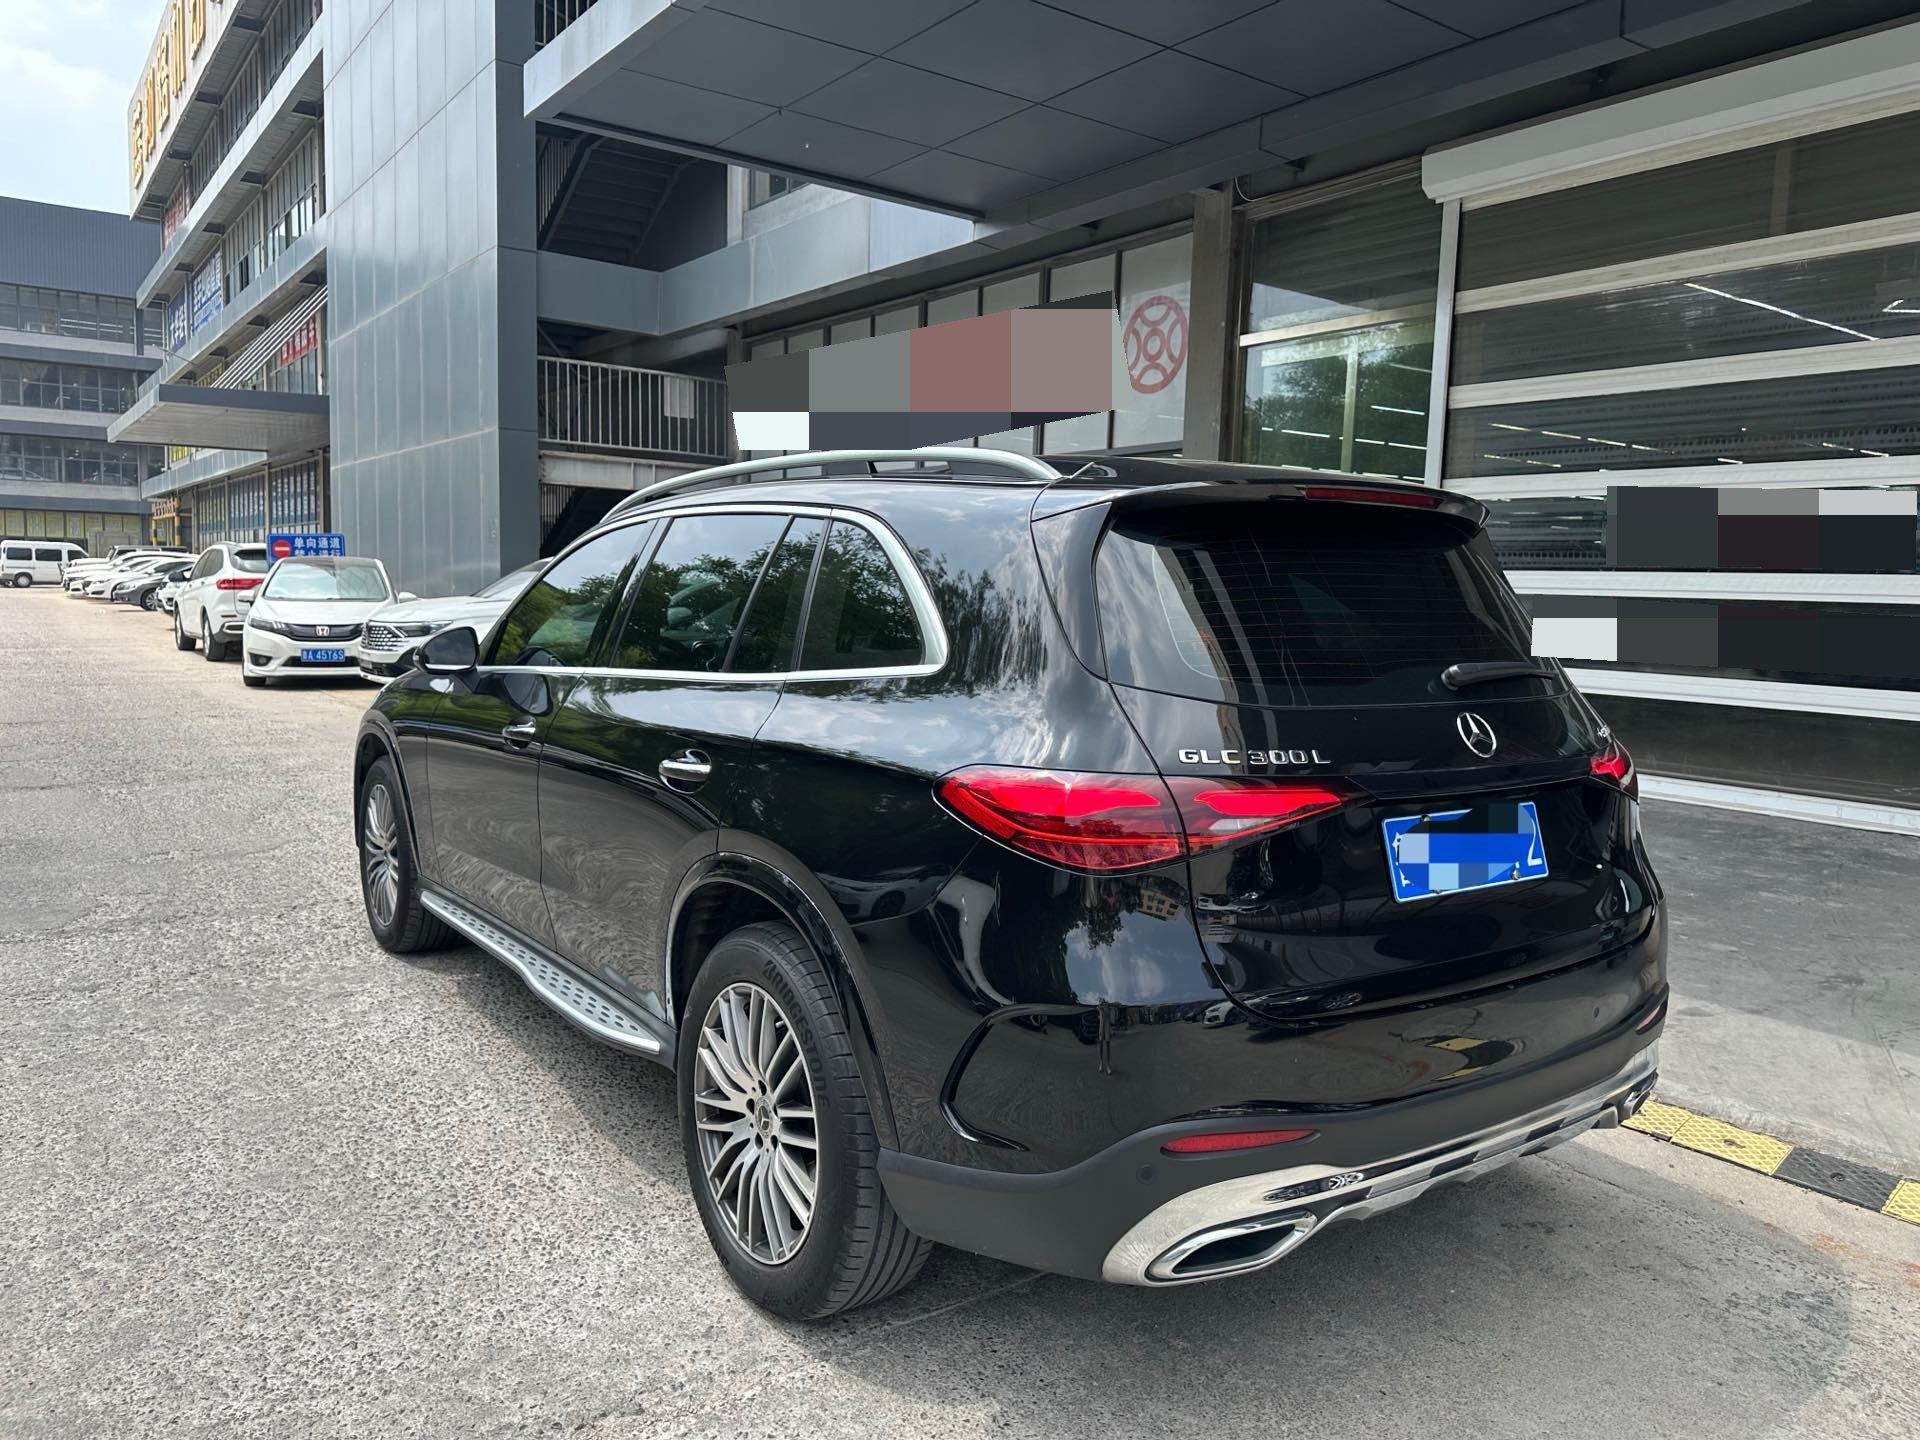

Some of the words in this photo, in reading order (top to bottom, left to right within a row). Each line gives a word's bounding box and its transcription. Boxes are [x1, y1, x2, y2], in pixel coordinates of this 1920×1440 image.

[293, 536, 341, 549] 单向通道
[1178, 749, 1241, 764] GLC
[762, 959, 830, 1109] BRIDGESTONE
